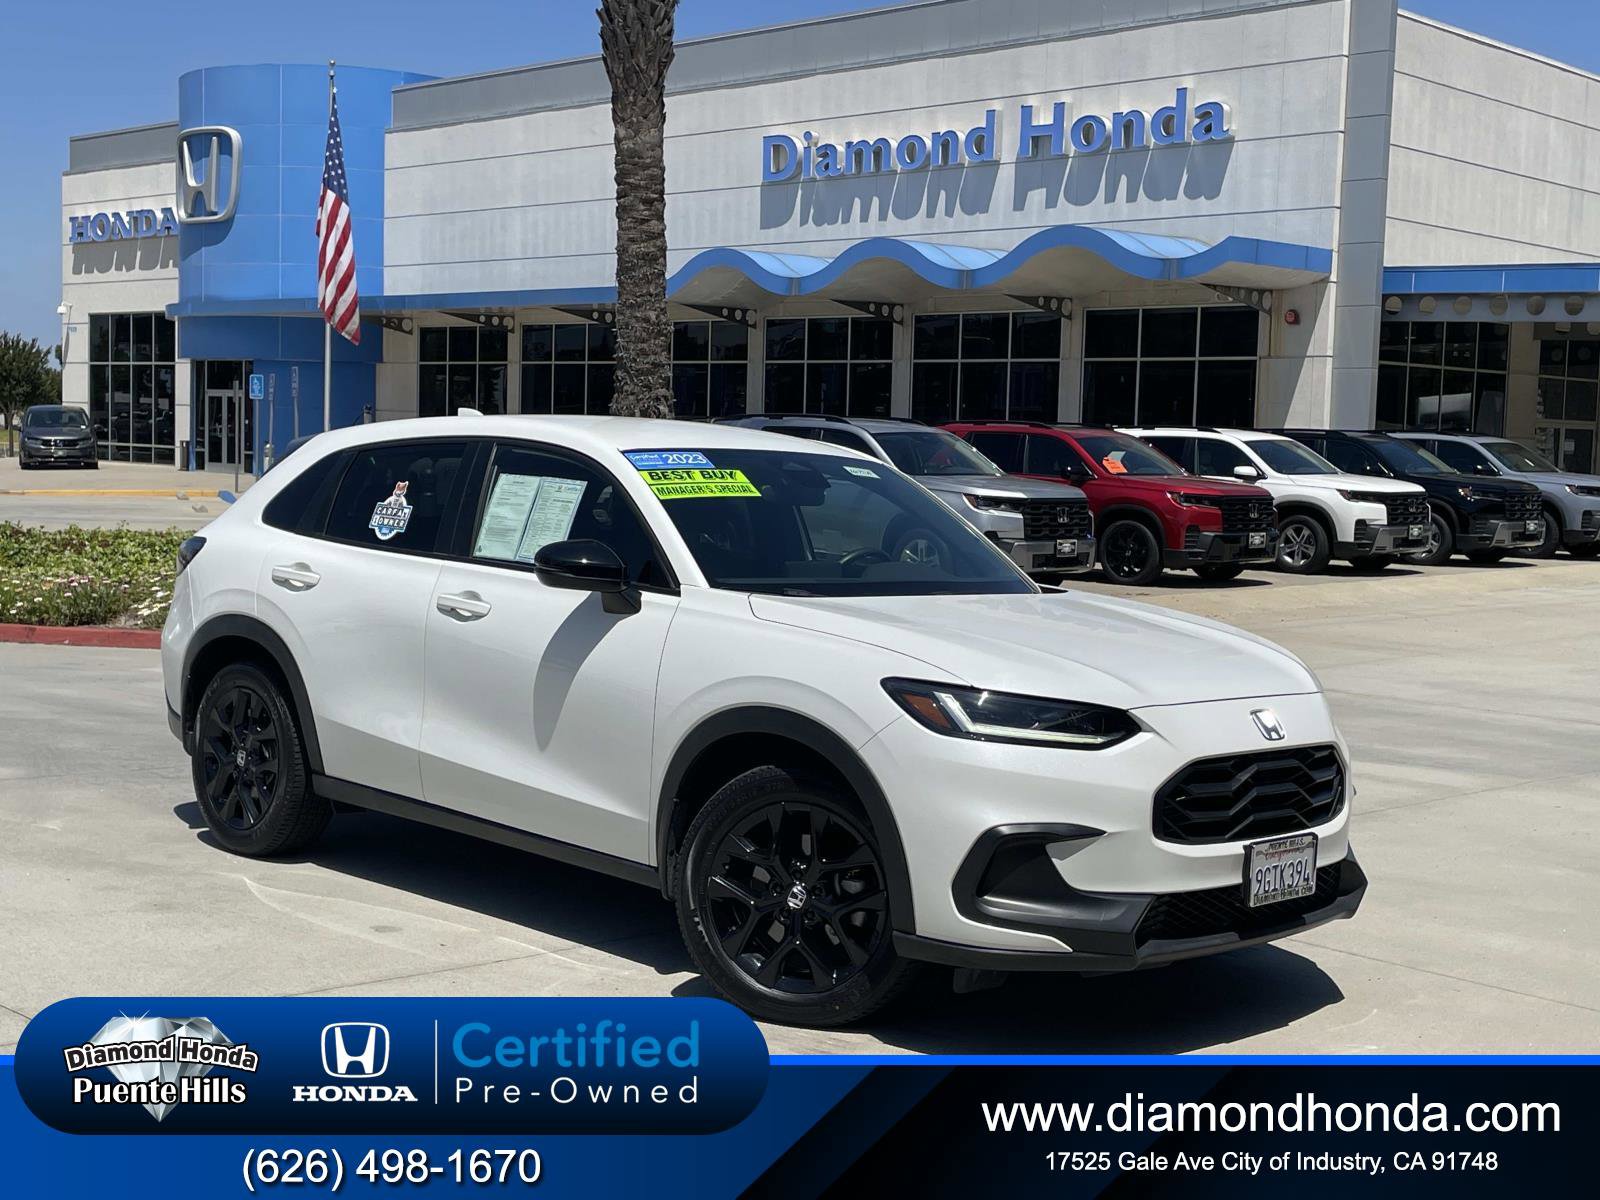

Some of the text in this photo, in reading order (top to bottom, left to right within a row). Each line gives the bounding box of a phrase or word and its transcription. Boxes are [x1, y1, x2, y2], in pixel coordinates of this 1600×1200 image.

[761, 87, 1233, 183] Diamond Honda
[69, 207, 179, 243] HONDA
[662, 453, 708, 465] 2023
[649, 470, 738, 482] BEST BUY
[656, 484, 754, 496] MANAGER'S SPECIAL
[376, 506, 410, 520] CARFAX
[1255, 857, 1311, 896] 9GIK394
